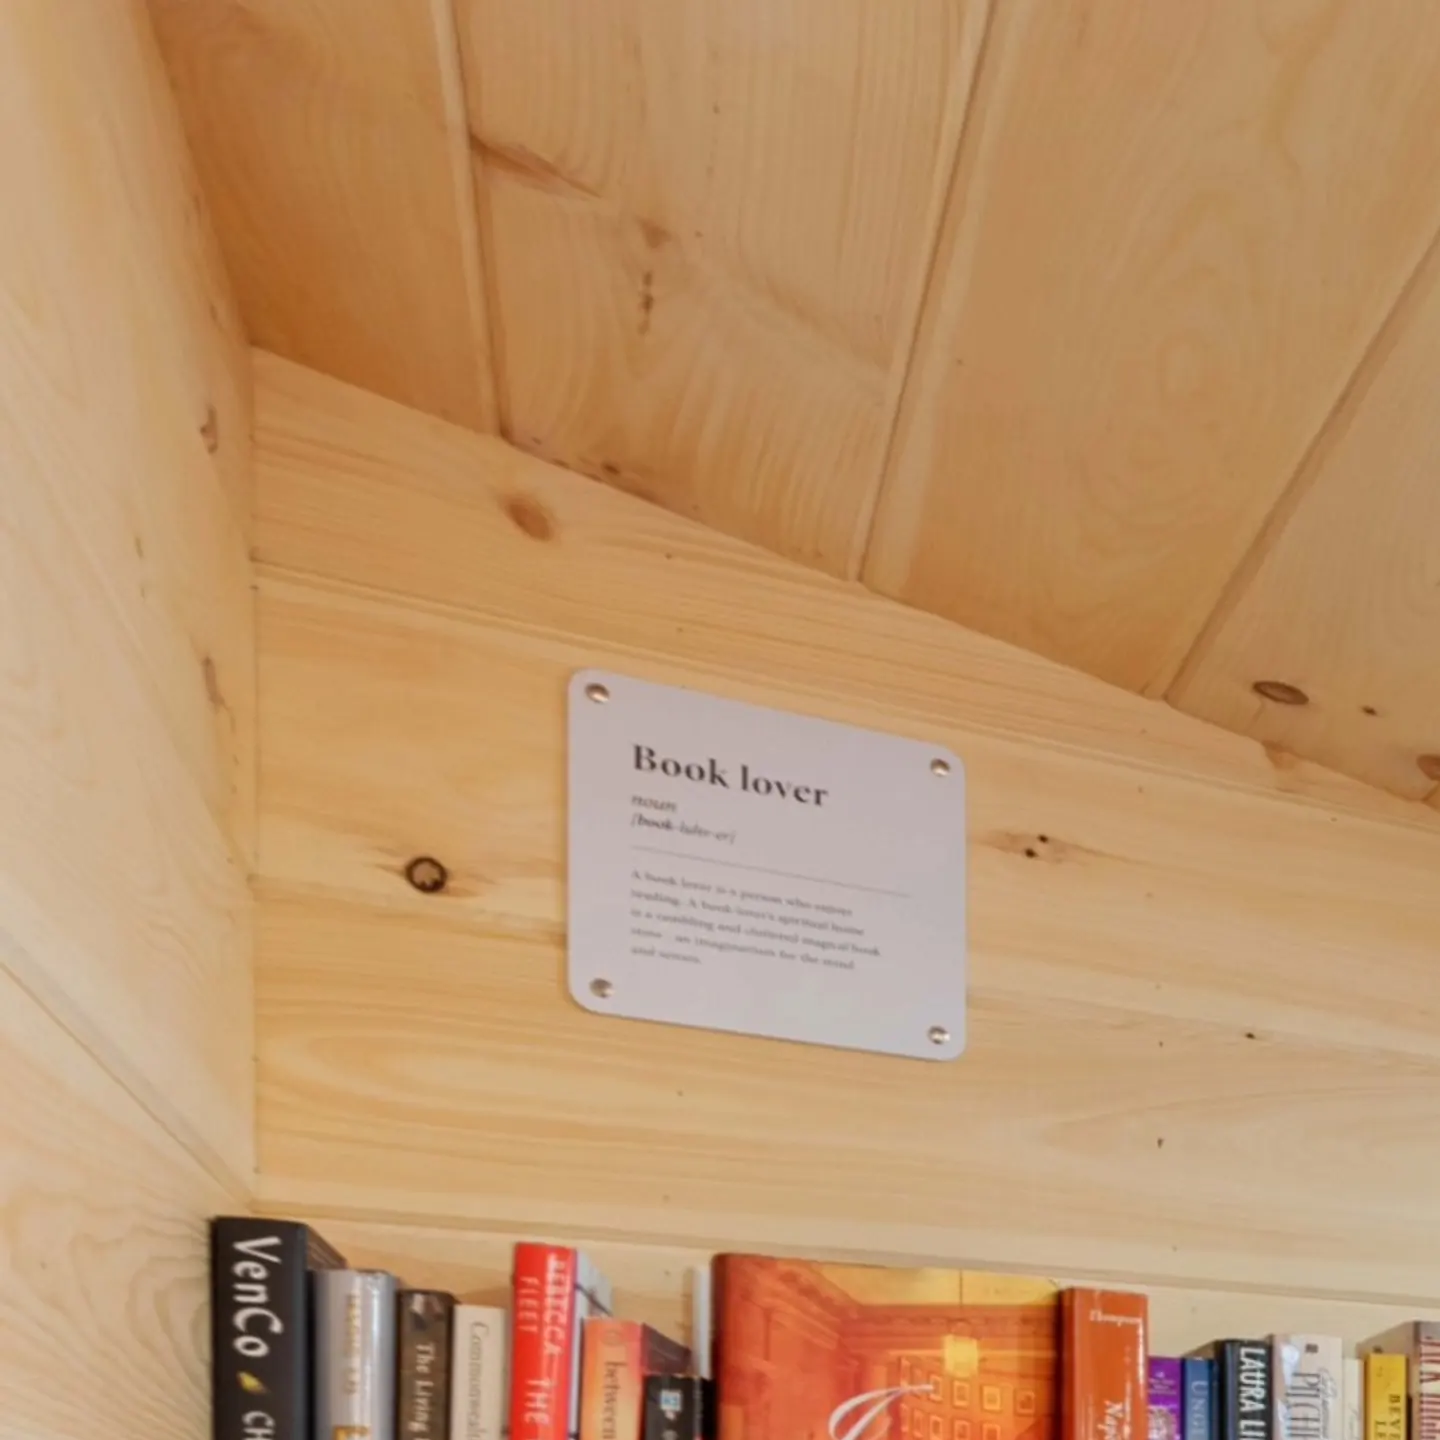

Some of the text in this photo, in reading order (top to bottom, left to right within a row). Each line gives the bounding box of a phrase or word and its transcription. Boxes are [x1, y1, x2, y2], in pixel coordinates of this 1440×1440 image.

[633, 744, 829, 806] Book lover
[231, 1235, 284, 1359] VenCo
[519, 1274, 540, 1336] FLEET
[412, 1341, 436, 1374] The
[1239, 1346, 1267, 1413] LAURA
[407, 1378, 436, 1433] Living
[524, 1378, 550, 1427] THE
[601, 1359, 629, 1439] between
